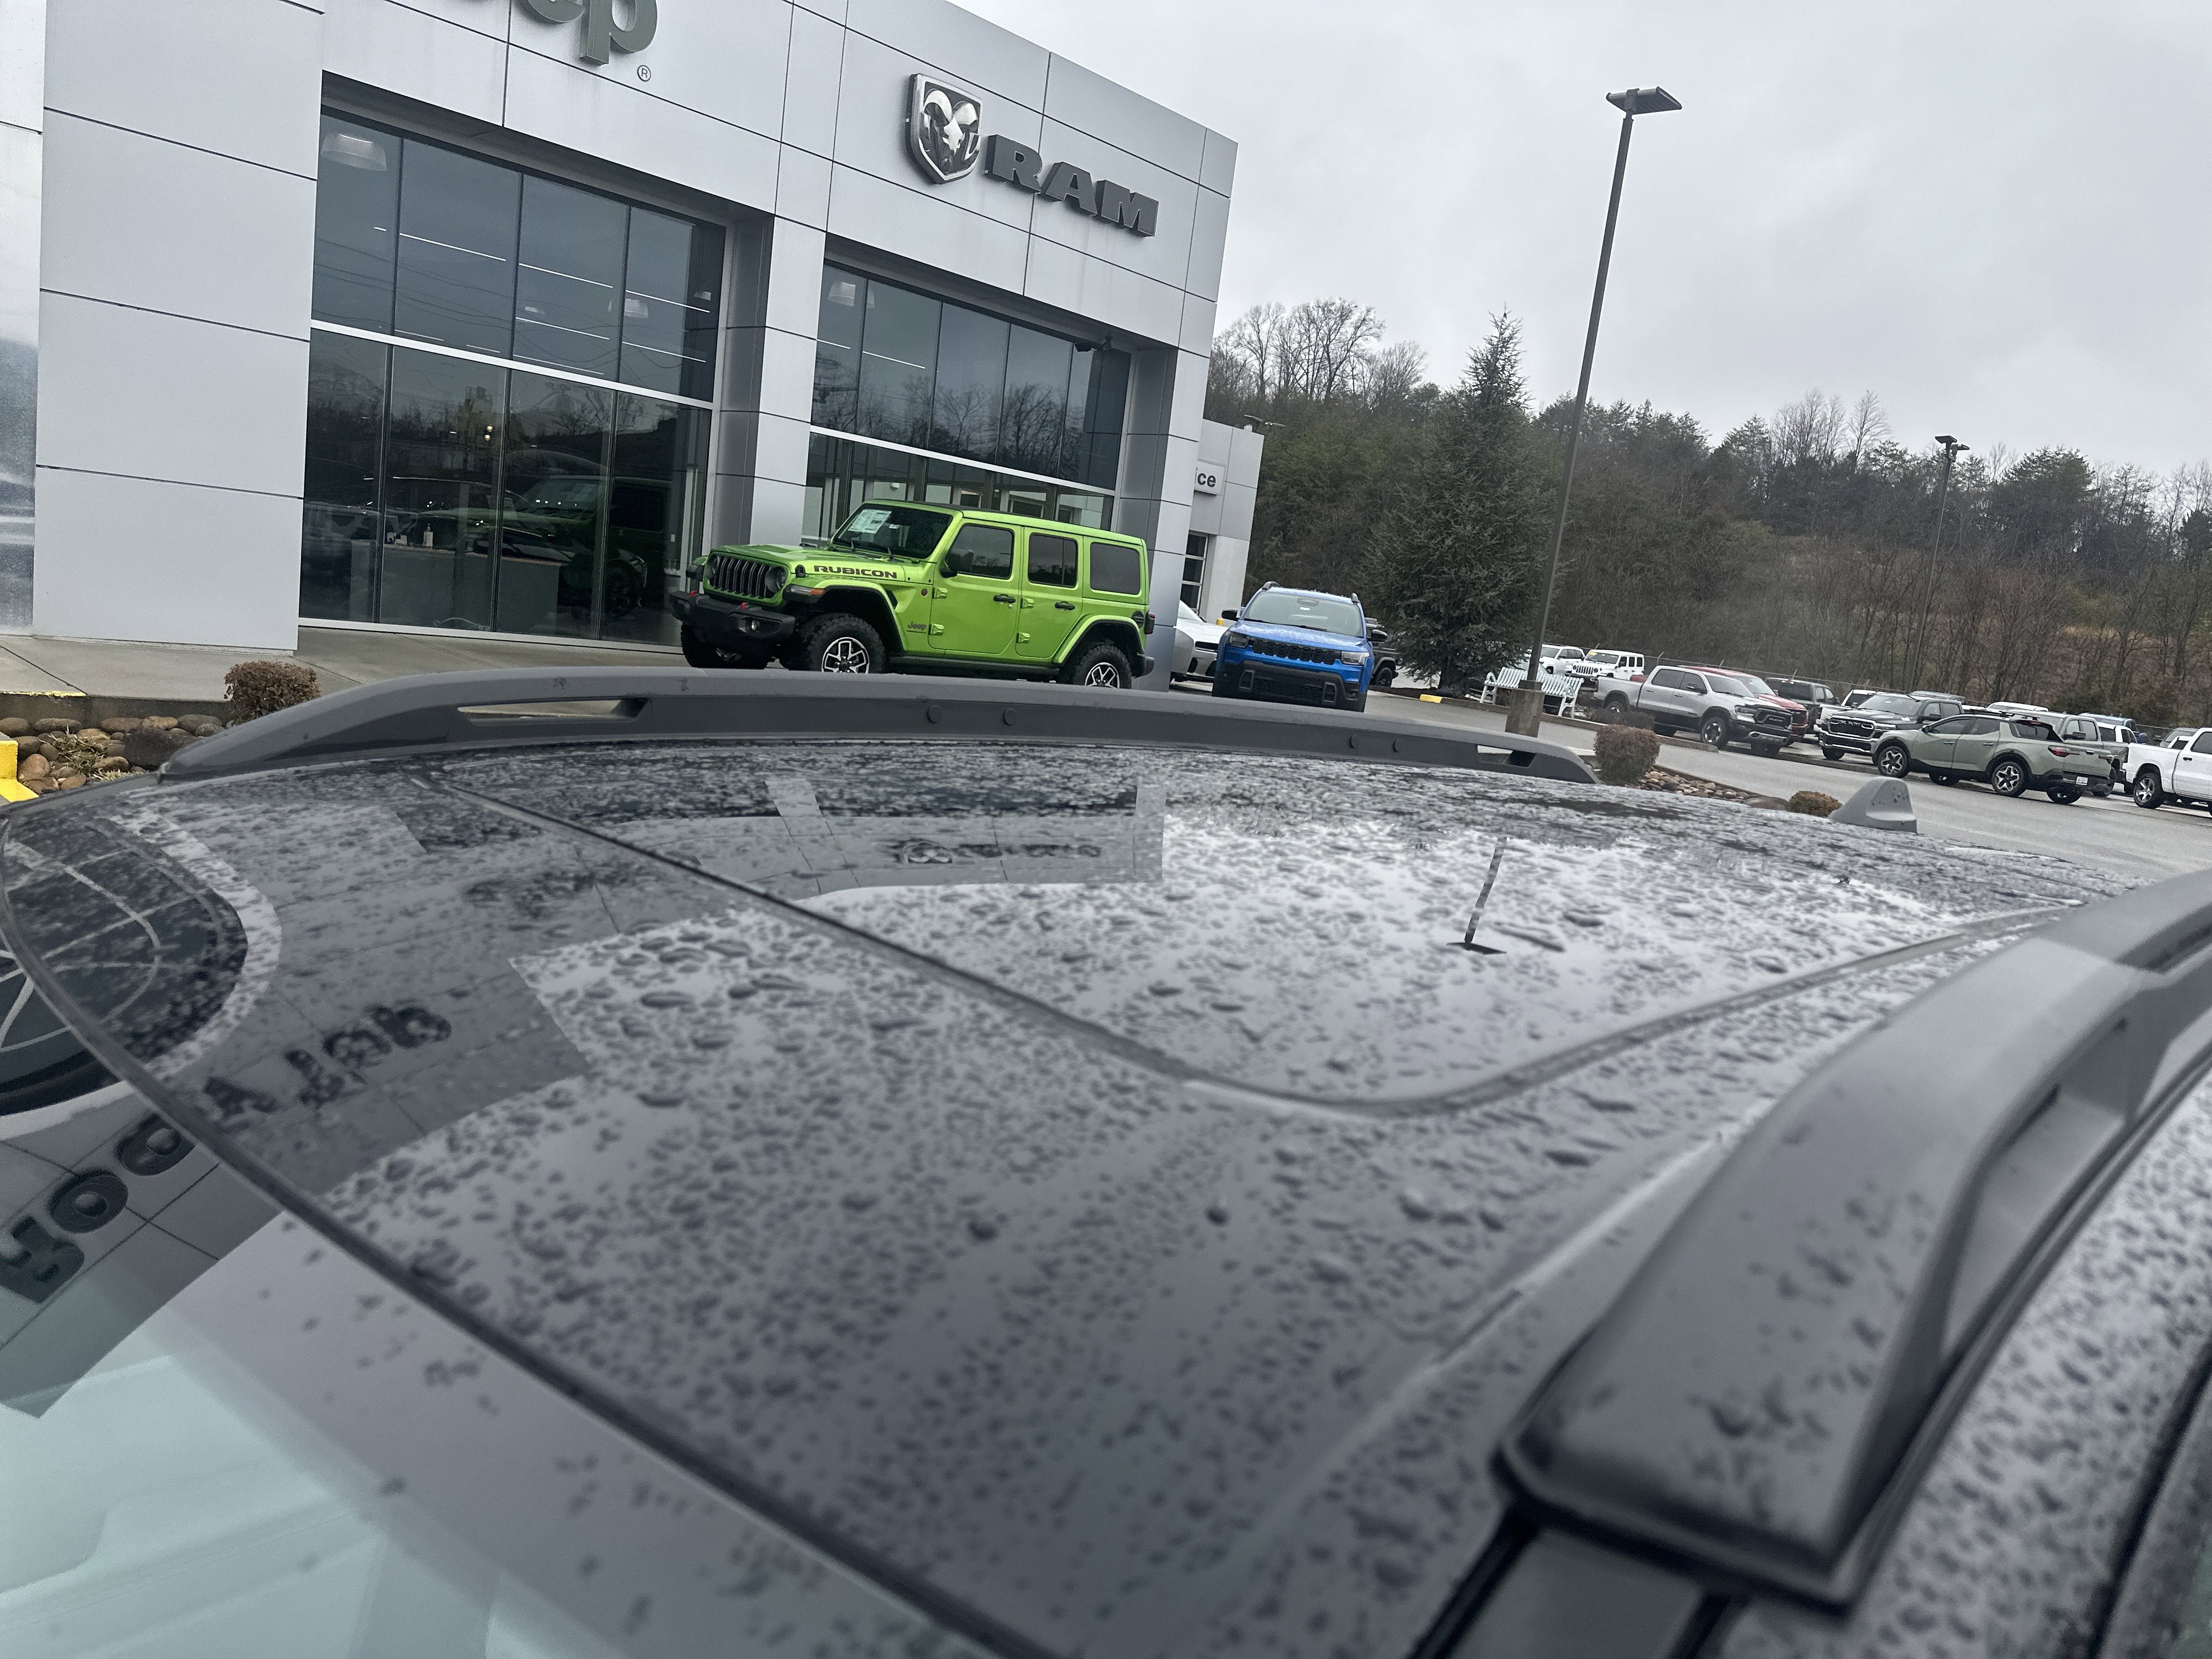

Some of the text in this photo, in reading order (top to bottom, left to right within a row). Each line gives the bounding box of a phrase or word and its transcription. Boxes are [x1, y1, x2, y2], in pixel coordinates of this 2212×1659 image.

[985, 134, 1159, 236] RAM
[814, 565, 897, 579] RUBICON
[907, 620, 926, 631] Jeep
